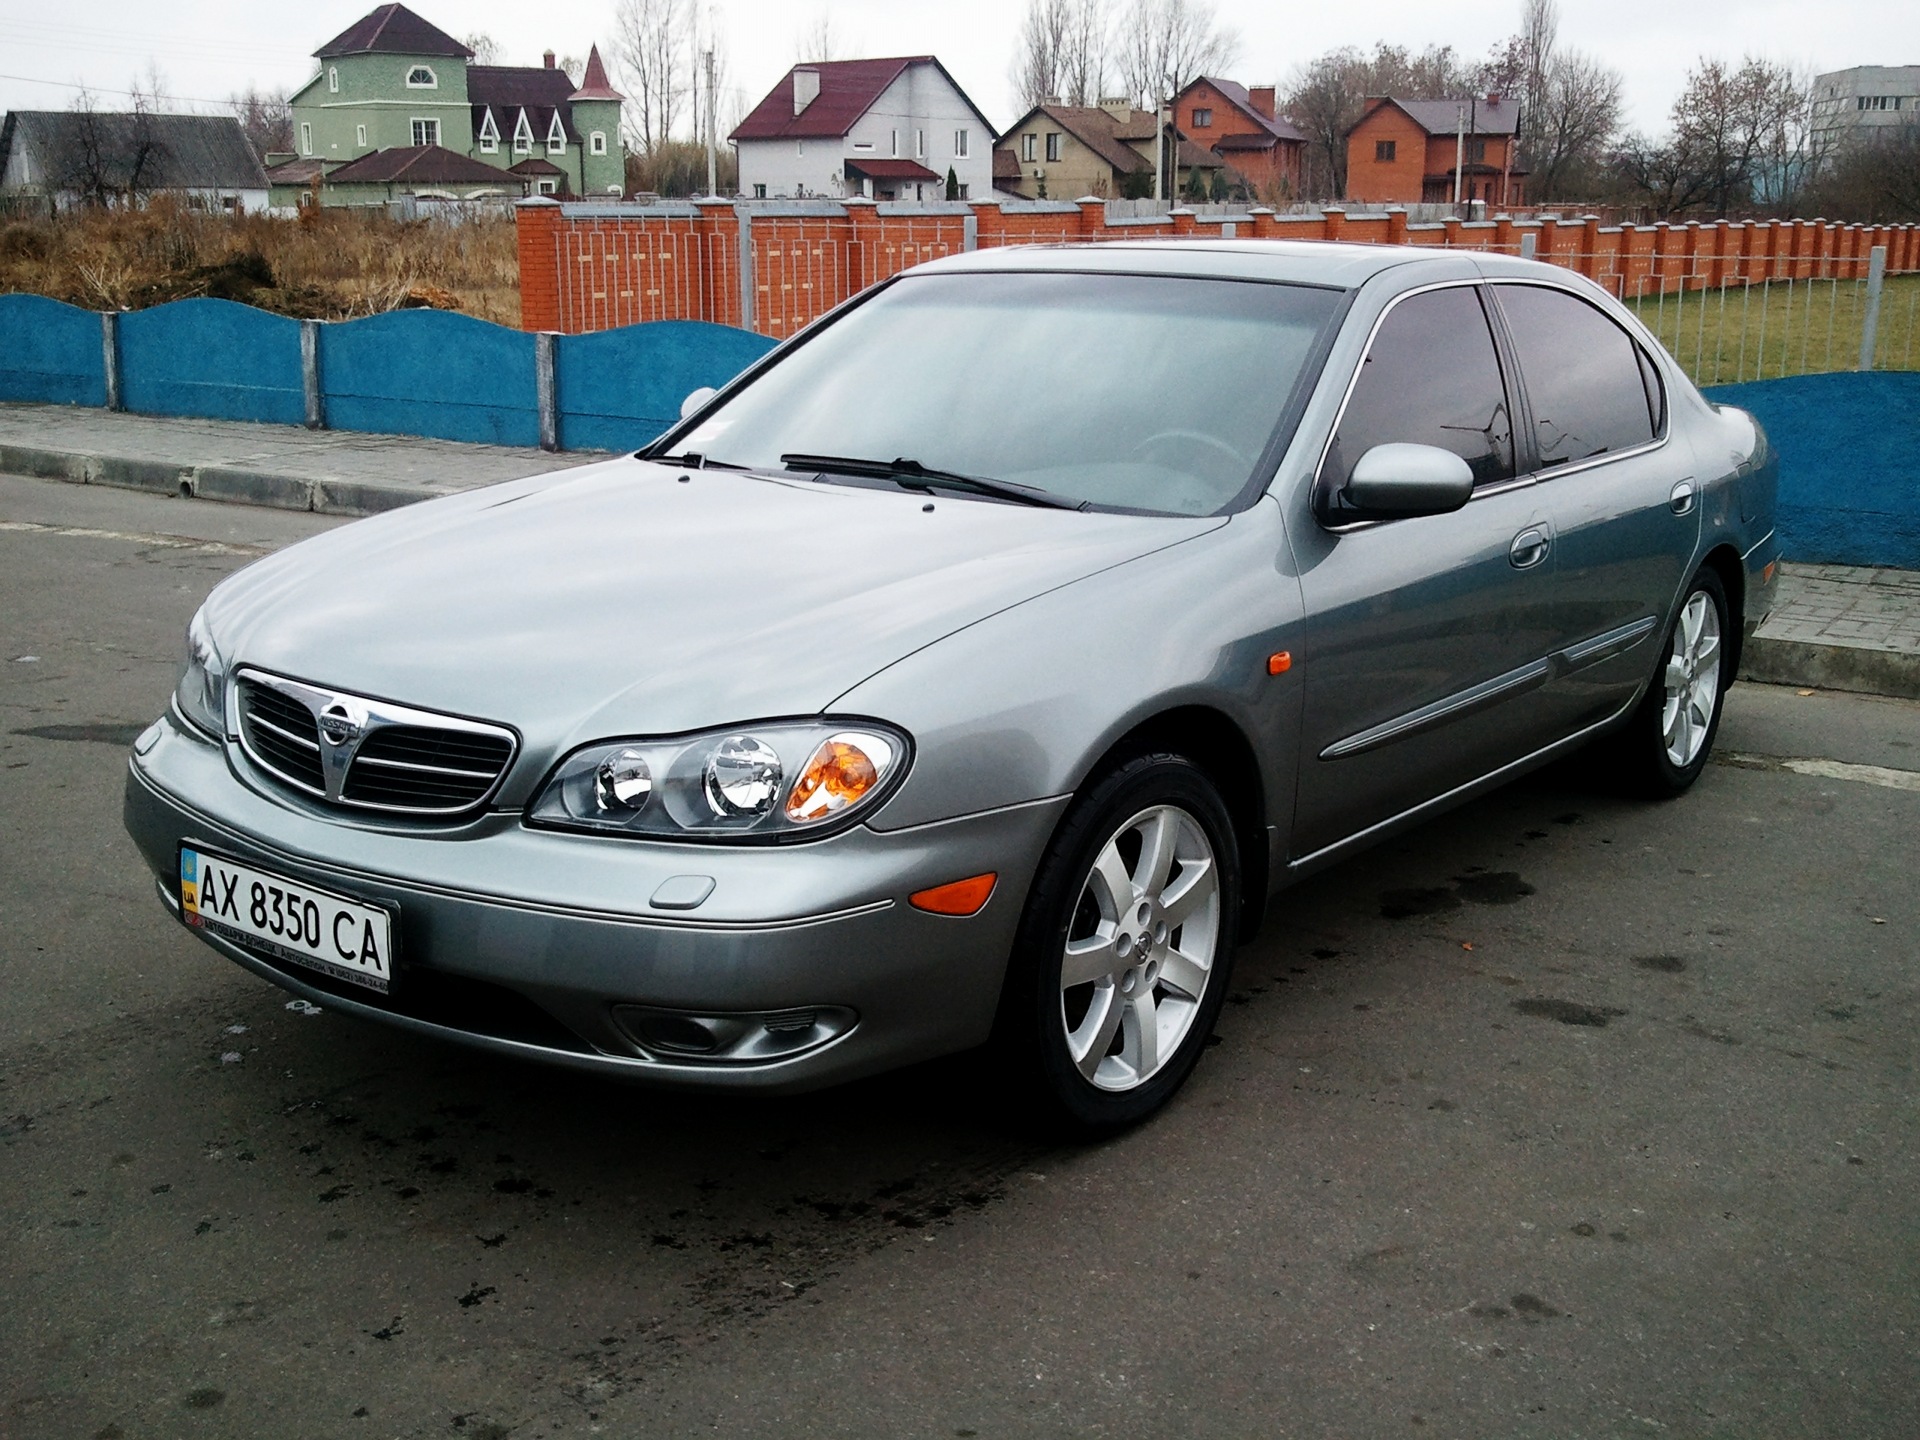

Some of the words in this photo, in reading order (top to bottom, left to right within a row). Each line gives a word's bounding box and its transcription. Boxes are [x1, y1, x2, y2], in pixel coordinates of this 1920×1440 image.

[183, 889, 196, 906] UA
[200, 864, 240, 921] AX
[250, 881, 320, 949] 8350
[333, 911, 382, 971] CA
